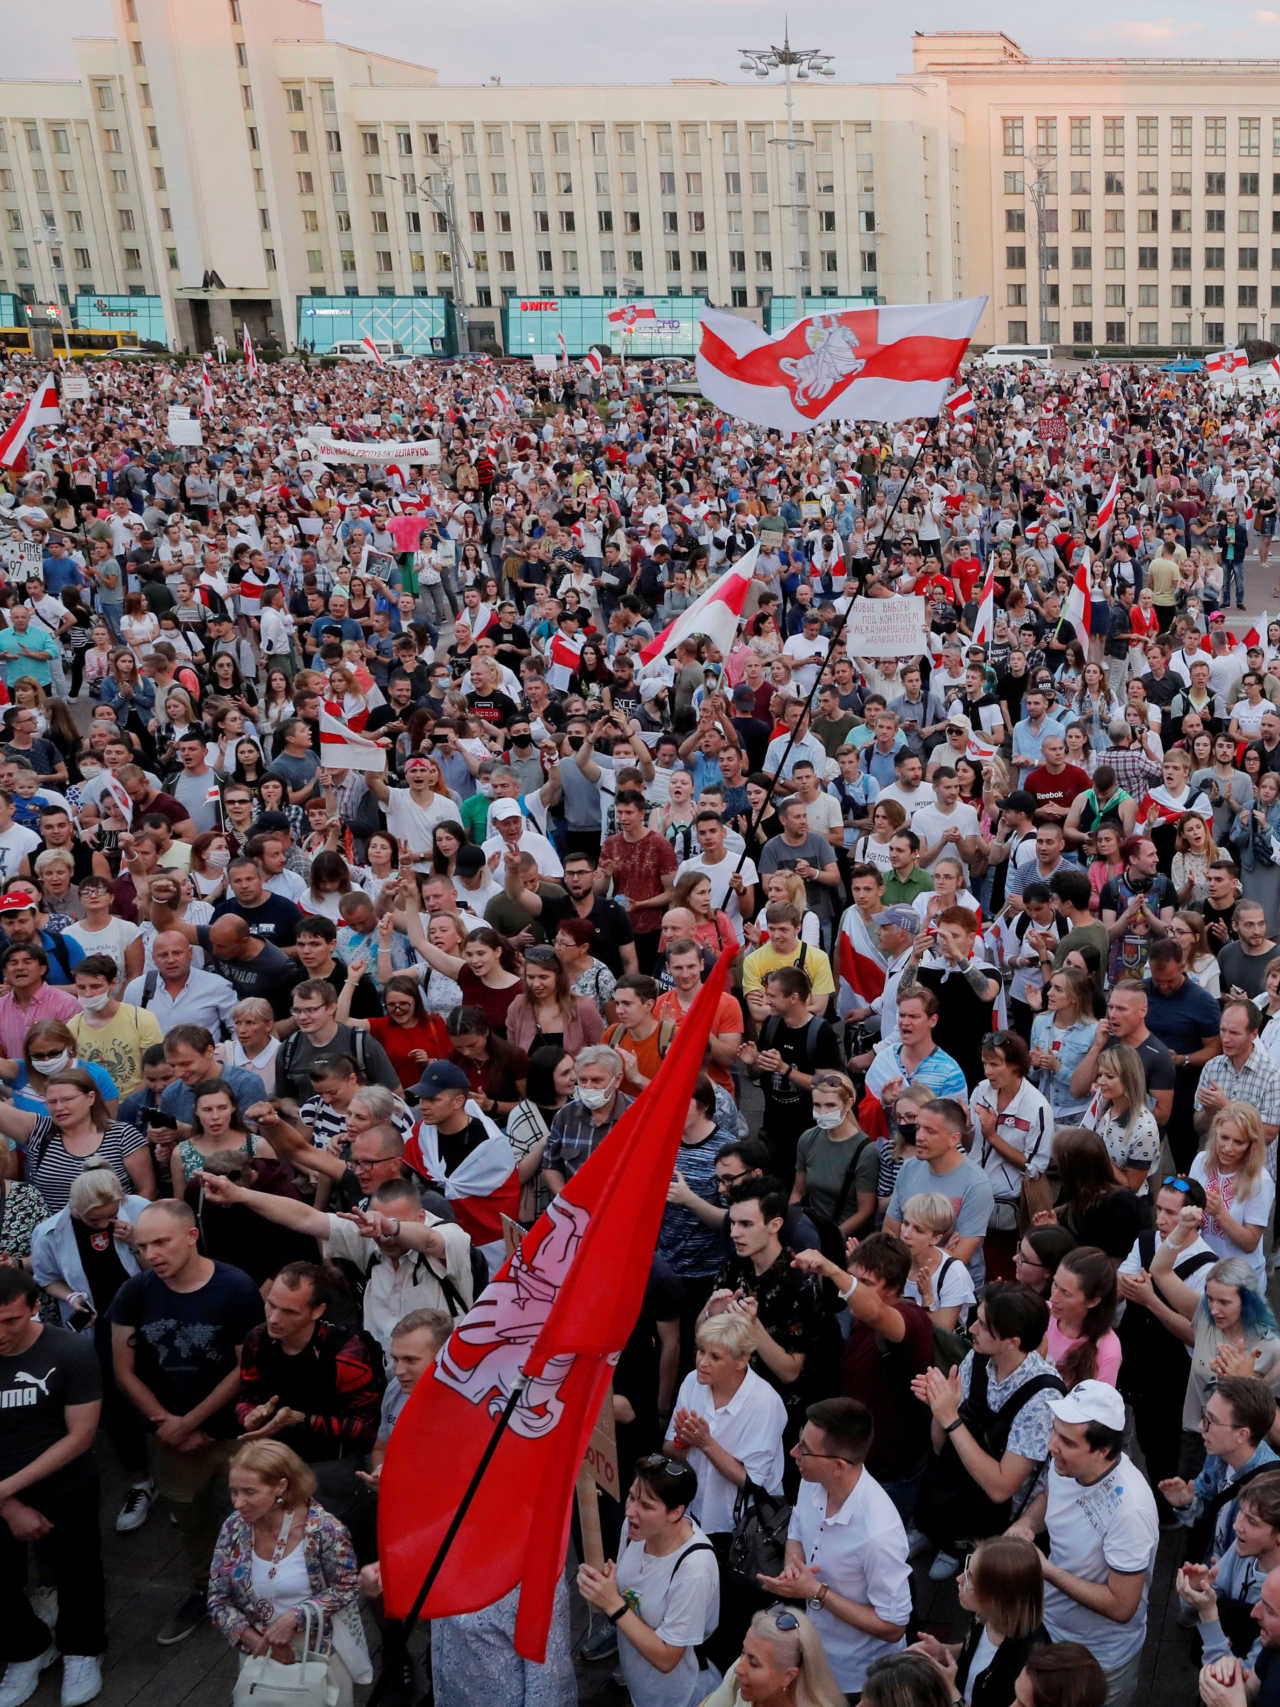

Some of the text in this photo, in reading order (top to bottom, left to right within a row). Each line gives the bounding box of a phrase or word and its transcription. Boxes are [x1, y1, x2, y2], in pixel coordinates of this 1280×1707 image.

[528, 302, 558, 311] МТС
[18, 543, 41, 554] GAME
[1036, 792, 1064, 801] Reebok
[0, 1387, 37, 1408] MA
[584, 1445, 615, 1483] ОГО
